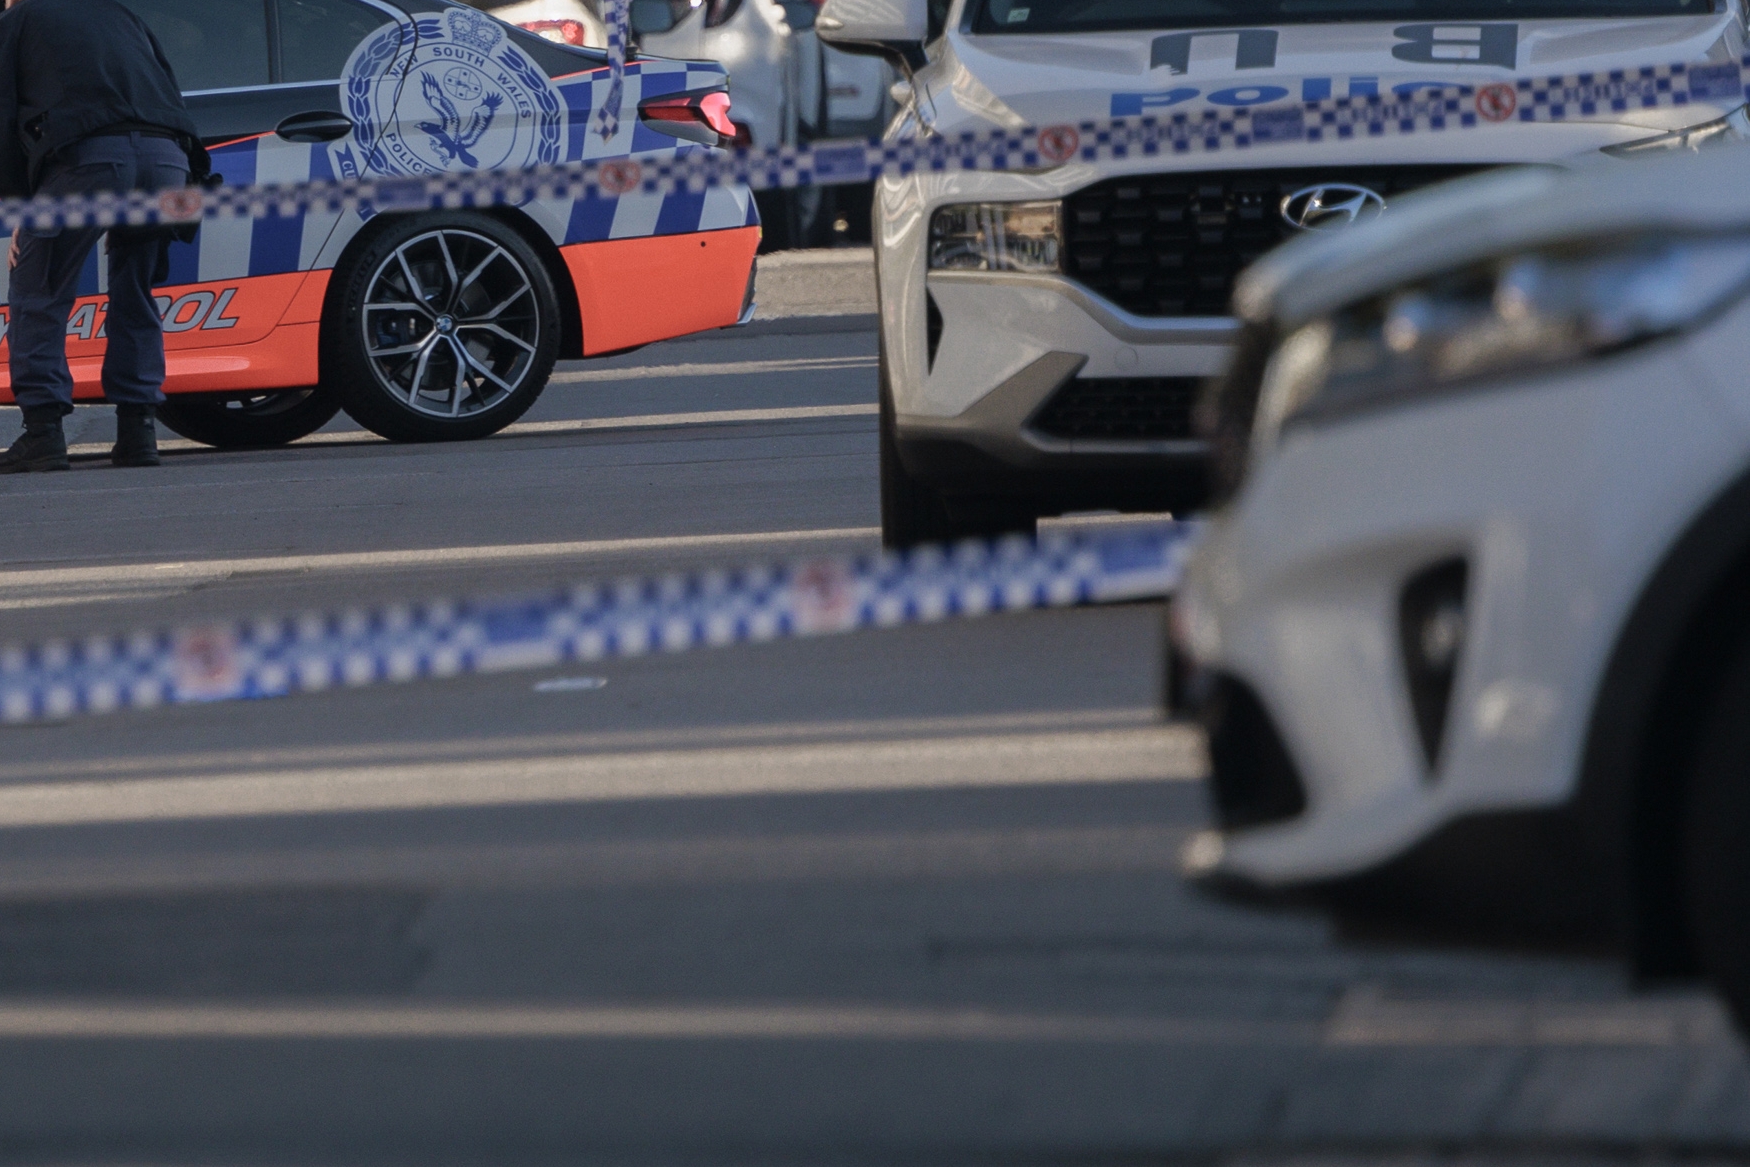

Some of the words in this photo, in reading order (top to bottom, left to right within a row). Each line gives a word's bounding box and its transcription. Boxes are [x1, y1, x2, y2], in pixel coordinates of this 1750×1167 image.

[389, 55, 419, 78] NEW
[433, 46, 486, 68] SOUTH
[496, 72, 532, 120] WALES
[385, 132, 433, 176] POLICE
